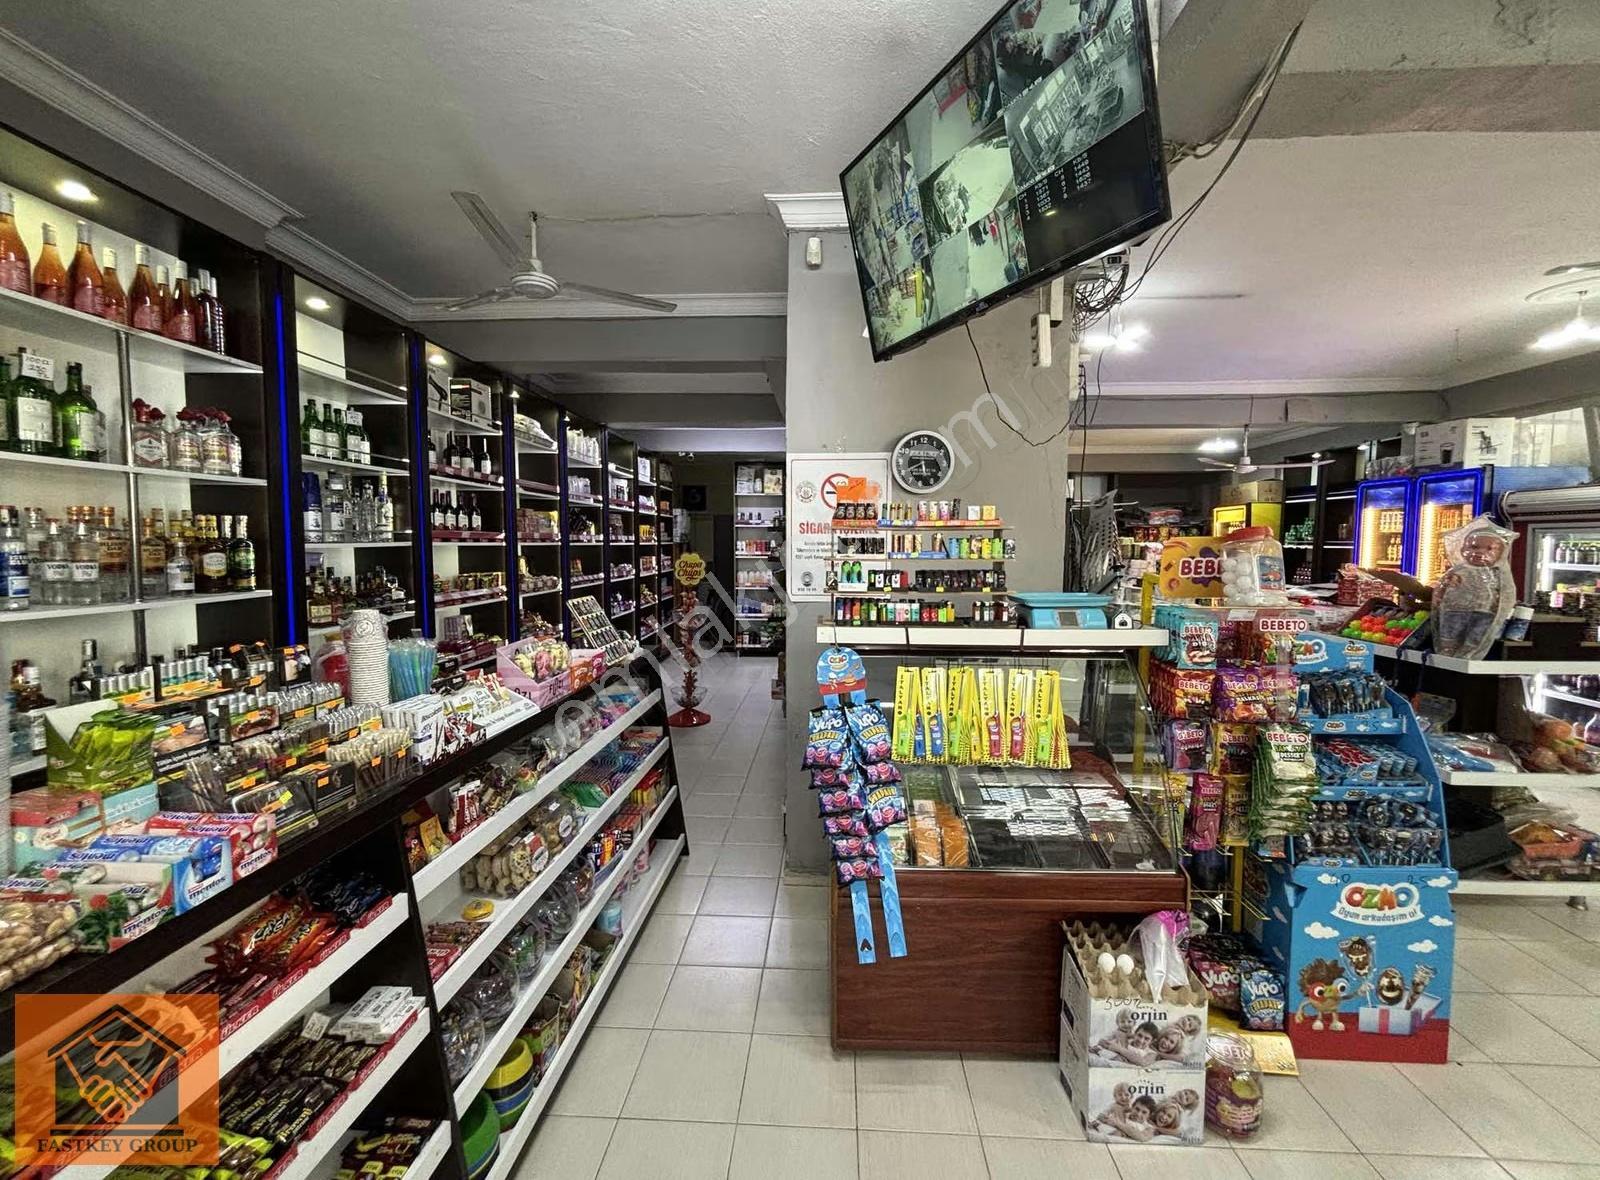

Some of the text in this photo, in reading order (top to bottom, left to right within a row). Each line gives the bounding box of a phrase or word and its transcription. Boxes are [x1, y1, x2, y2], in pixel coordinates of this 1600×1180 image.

[1261, 620, 1306, 631] BEBETO
[1179, 680, 1210, 691] BEBETO
[1267, 733, 1308, 743] BEBETO
[188, 877, 227, 900] mentos
[1345, 886, 1414, 911] OZMO
